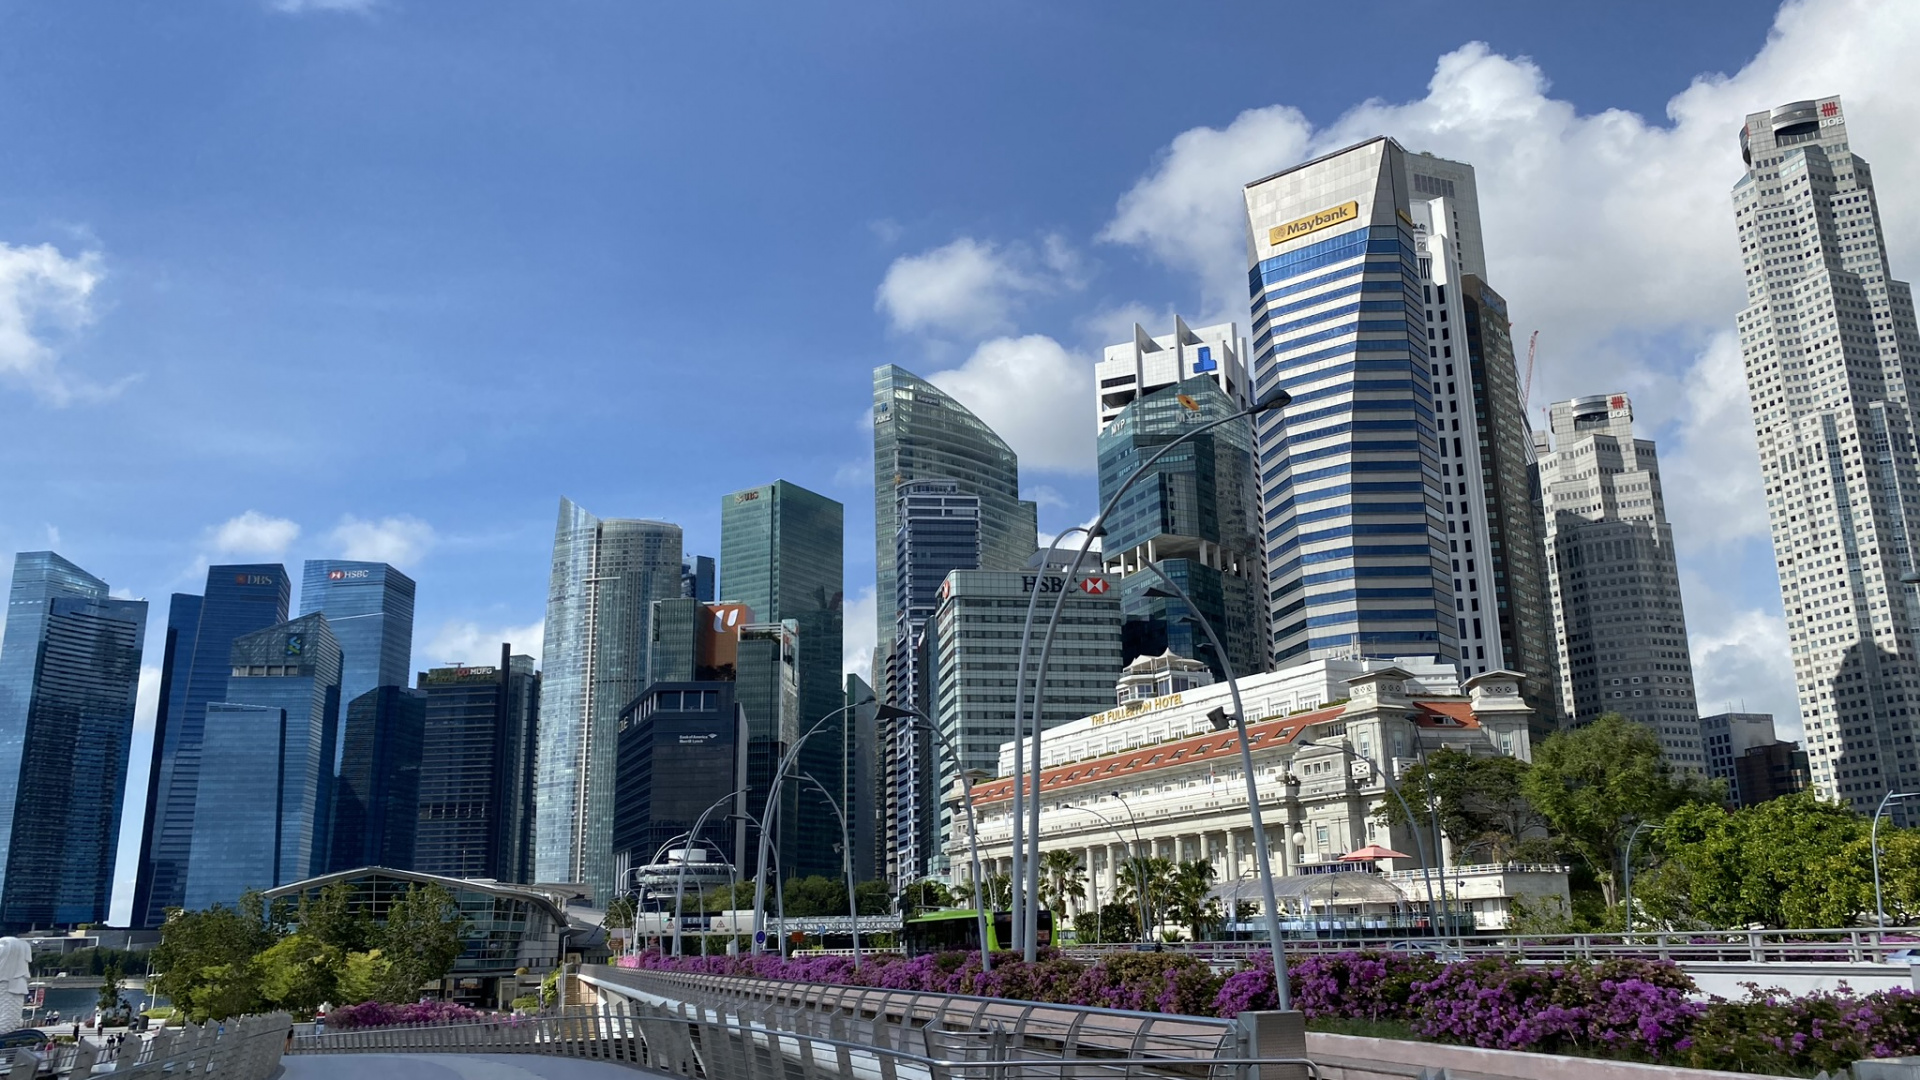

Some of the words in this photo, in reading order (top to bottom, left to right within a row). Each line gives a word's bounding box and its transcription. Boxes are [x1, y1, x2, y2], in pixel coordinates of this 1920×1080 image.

[1819, 116, 1844, 129] UOB
[1287, 207, 1348, 235] Maybank
[1176, 411, 1202, 423] MYP
[1608, 410, 1629, 419] UOB
[1111, 419, 1126, 435] MYP
[744, 491, 759, 501] UBS
[247, 575, 272, 585] DBS
[344, 570, 369, 578] HSBC
[1091, 714, 1105, 726] THE
[1107, 700, 1152, 722] FULLERTON
[1154, 693, 1184, 710] HOTEL
